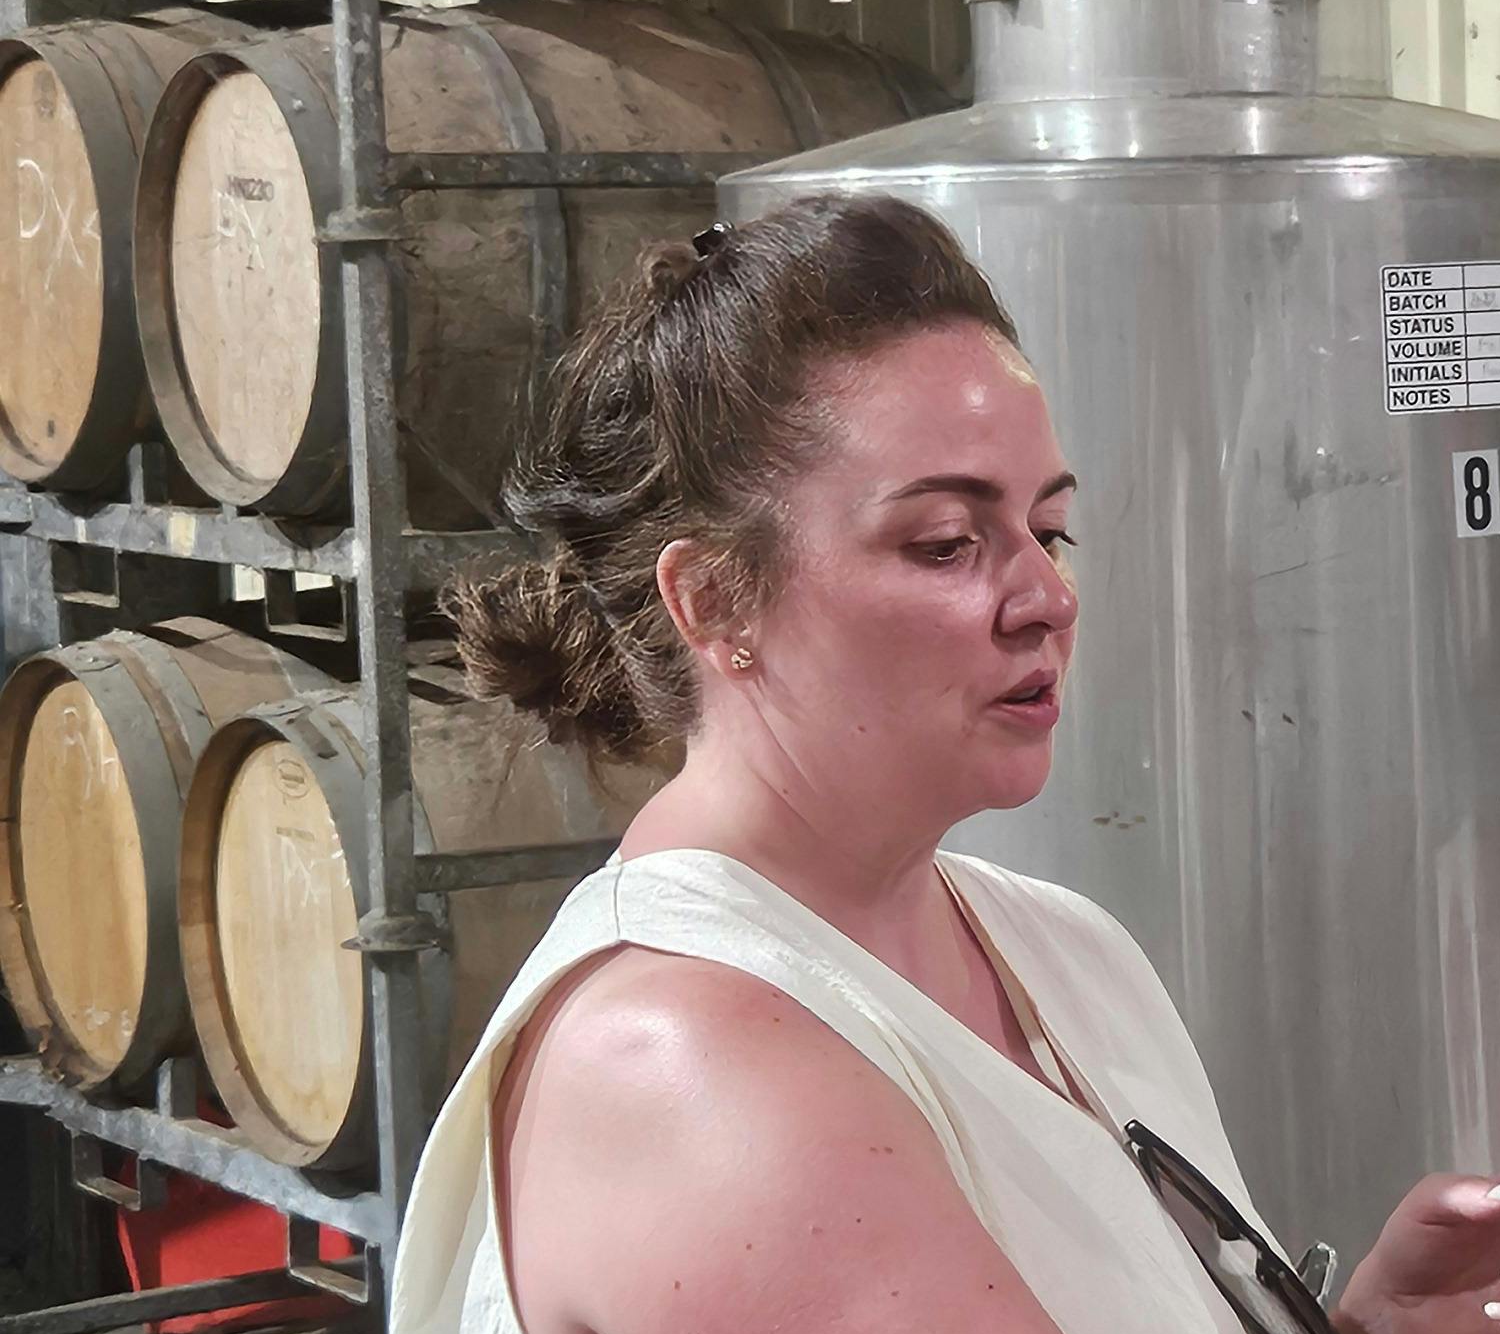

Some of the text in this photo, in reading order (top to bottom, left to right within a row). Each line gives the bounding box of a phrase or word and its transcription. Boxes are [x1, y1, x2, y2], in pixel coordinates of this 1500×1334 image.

[1387, 271, 1433, 287] DATE
[1389, 294, 1447, 312] BATCH
[1390, 317, 1455, 335] STATUS
[1391, 340, 1462, 359] VOLUME
[1392, 364, 1462, 383] INITIALS
[1393, 388, 1451, 407] NOTES
[1463, 456, 1492, 531] 8
